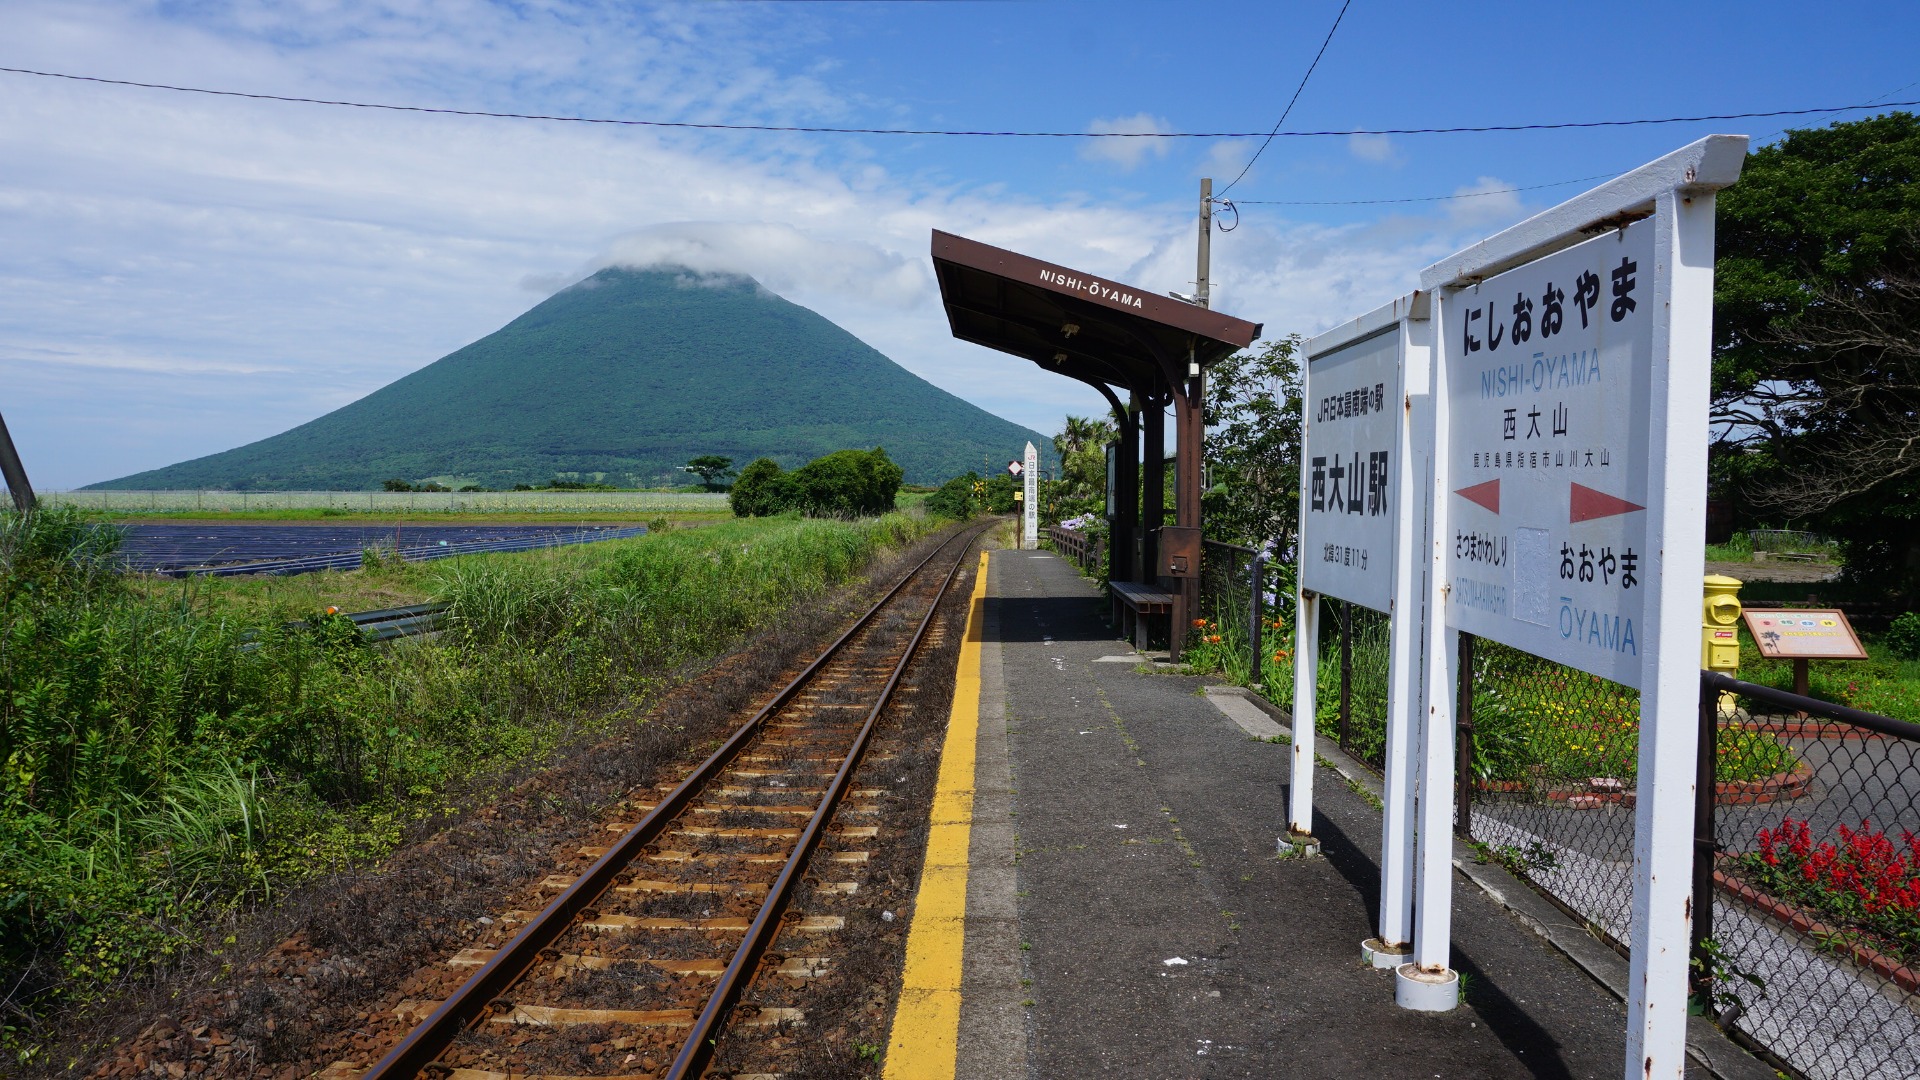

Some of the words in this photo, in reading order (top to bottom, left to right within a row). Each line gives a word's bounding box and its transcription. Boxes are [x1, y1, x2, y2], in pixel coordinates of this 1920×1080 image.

[1464, 257, 1637, 356] にしおおやま
[1481, 348, 1600, 399] NISHI-ŌYAMA
[1318, 383, 1383, 423] JR日本最南端の駅
[1503, 402, 1567, 441] 西大山
[1473, 448, 1610, 469] 鹿児島県指宿市山川大山
[1311, 451, 1388, 517] 西大山駅
[1456, 529, 1507, 567] さつまかわしり
[1560, 542, 1638, 589] おおやま
[1560, 596, 1636, 656] ŌYAMA
